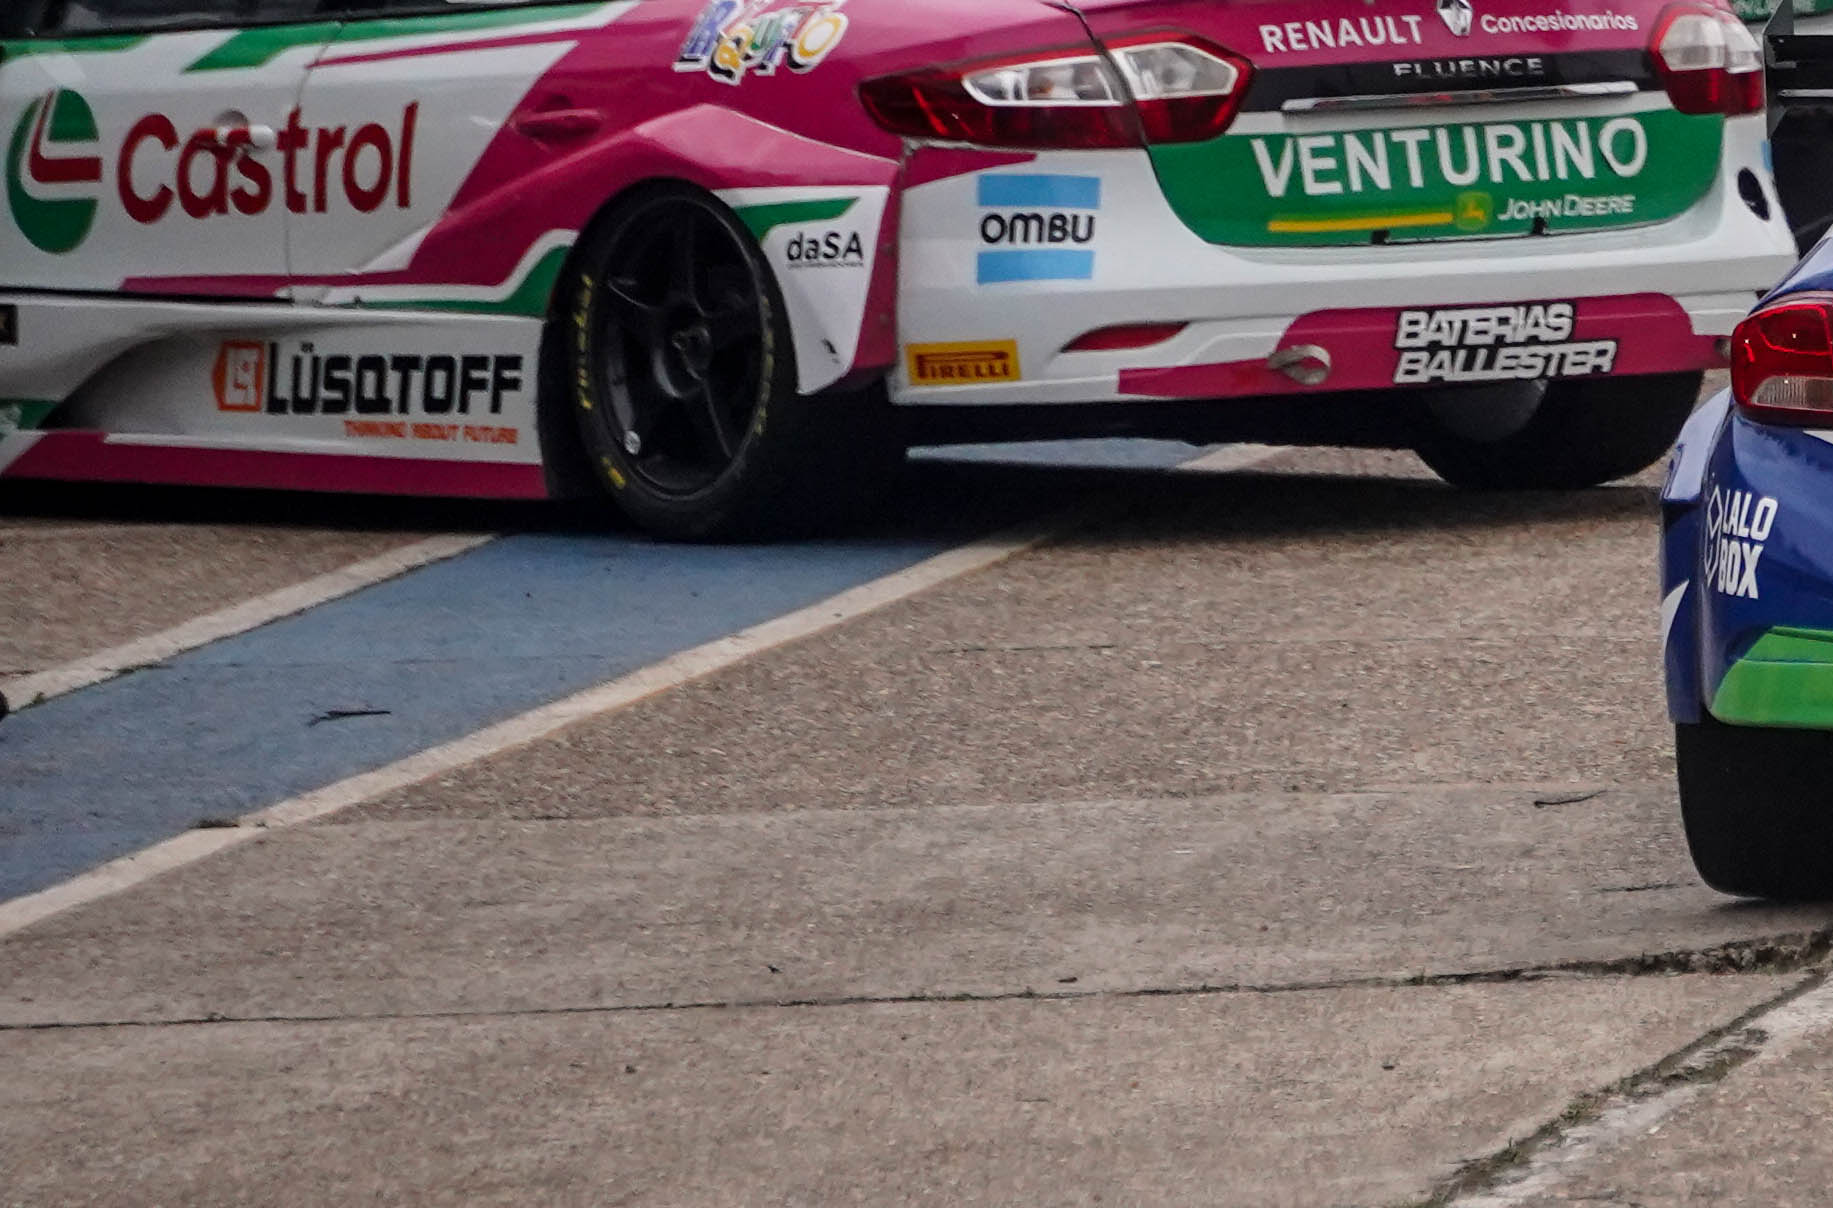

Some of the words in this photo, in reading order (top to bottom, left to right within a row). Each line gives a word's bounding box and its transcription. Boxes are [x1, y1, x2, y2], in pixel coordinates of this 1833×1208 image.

[1259, 13, 1422, 55] RENAULT
[1480, 9, 1639, 36] Concesionarios
[1392, 54, 1546, 81] FLUENCE
[116, 102, 419, 224] Castrol
[1250, 116, 1649, 197] VENTURINO
[787, 232, 864, 261] daSA
[981, 211, 1095, 246] OMBU
[1395, 302, 1574, 348] BATERIAS
[266, 341, 524, 415] LÜSQTOFF
[916, 350, 1010, 380] PIRELLI
[1393, 340, 1617, 384] BALLESTER
[1722, 488, 1779, 542] LALO
[1717, 537, 1765, 600] BOX
